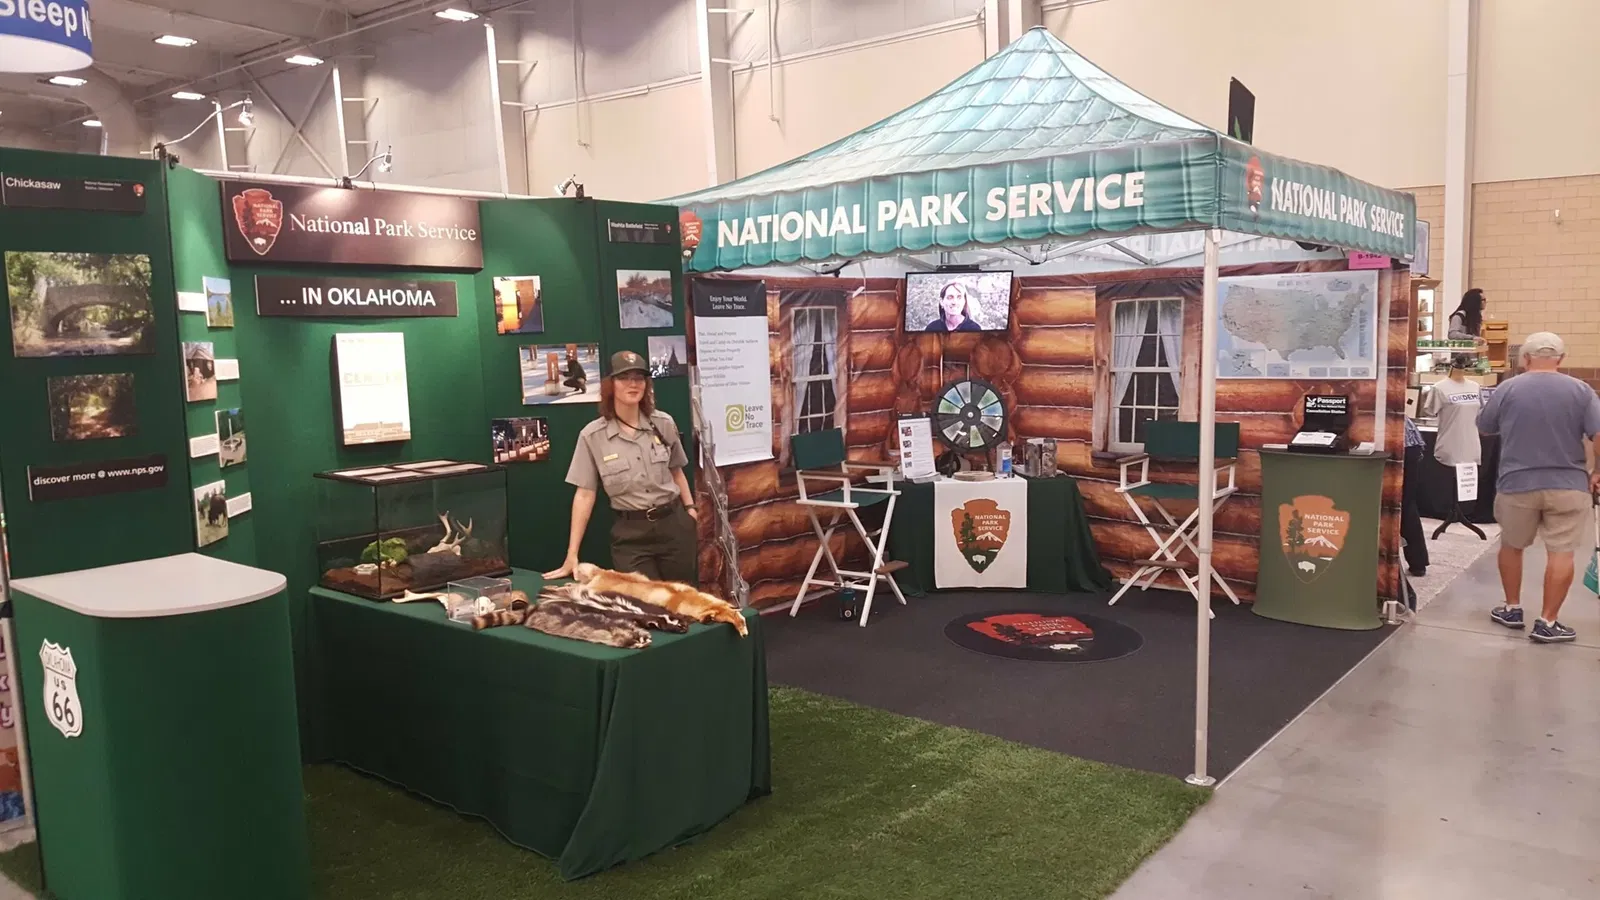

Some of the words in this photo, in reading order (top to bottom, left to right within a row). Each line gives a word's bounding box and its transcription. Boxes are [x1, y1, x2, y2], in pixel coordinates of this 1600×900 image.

[5, 177, 61, 190] Chickasaw
[717, 203, 867, 249] NATIONAL
[877, 190, 969, 232] PARK
[985, 170, 1146, 220] SERVICE
[1270, 177, 1337, 221] NATIONAL
[1340, 194, 1367, 229] PARK
[1370, 204, 1405, 238] SERVICE
[289, 213, 371, 236] National
[374, 218, 414, 238] Park
[417, 222, 477, 241] Service
[302, 287, 322, 305] IN
[327, 287, 437, 307] OKLAHOMA
[745, 404, 764, 412] Leave
[745, 421, 764, 429] Trace
[33, 475, 71, 486] discover
[72, 472, 96, 481] more
[97, 470, 106, 478] @
[107, 465, 164, 477] www.nps.gov
[1304, 513, 1345, 522] NATIONAL
[1307, 527, 1340, 535] SERVICE
[52, 691, 75, 728] 66
